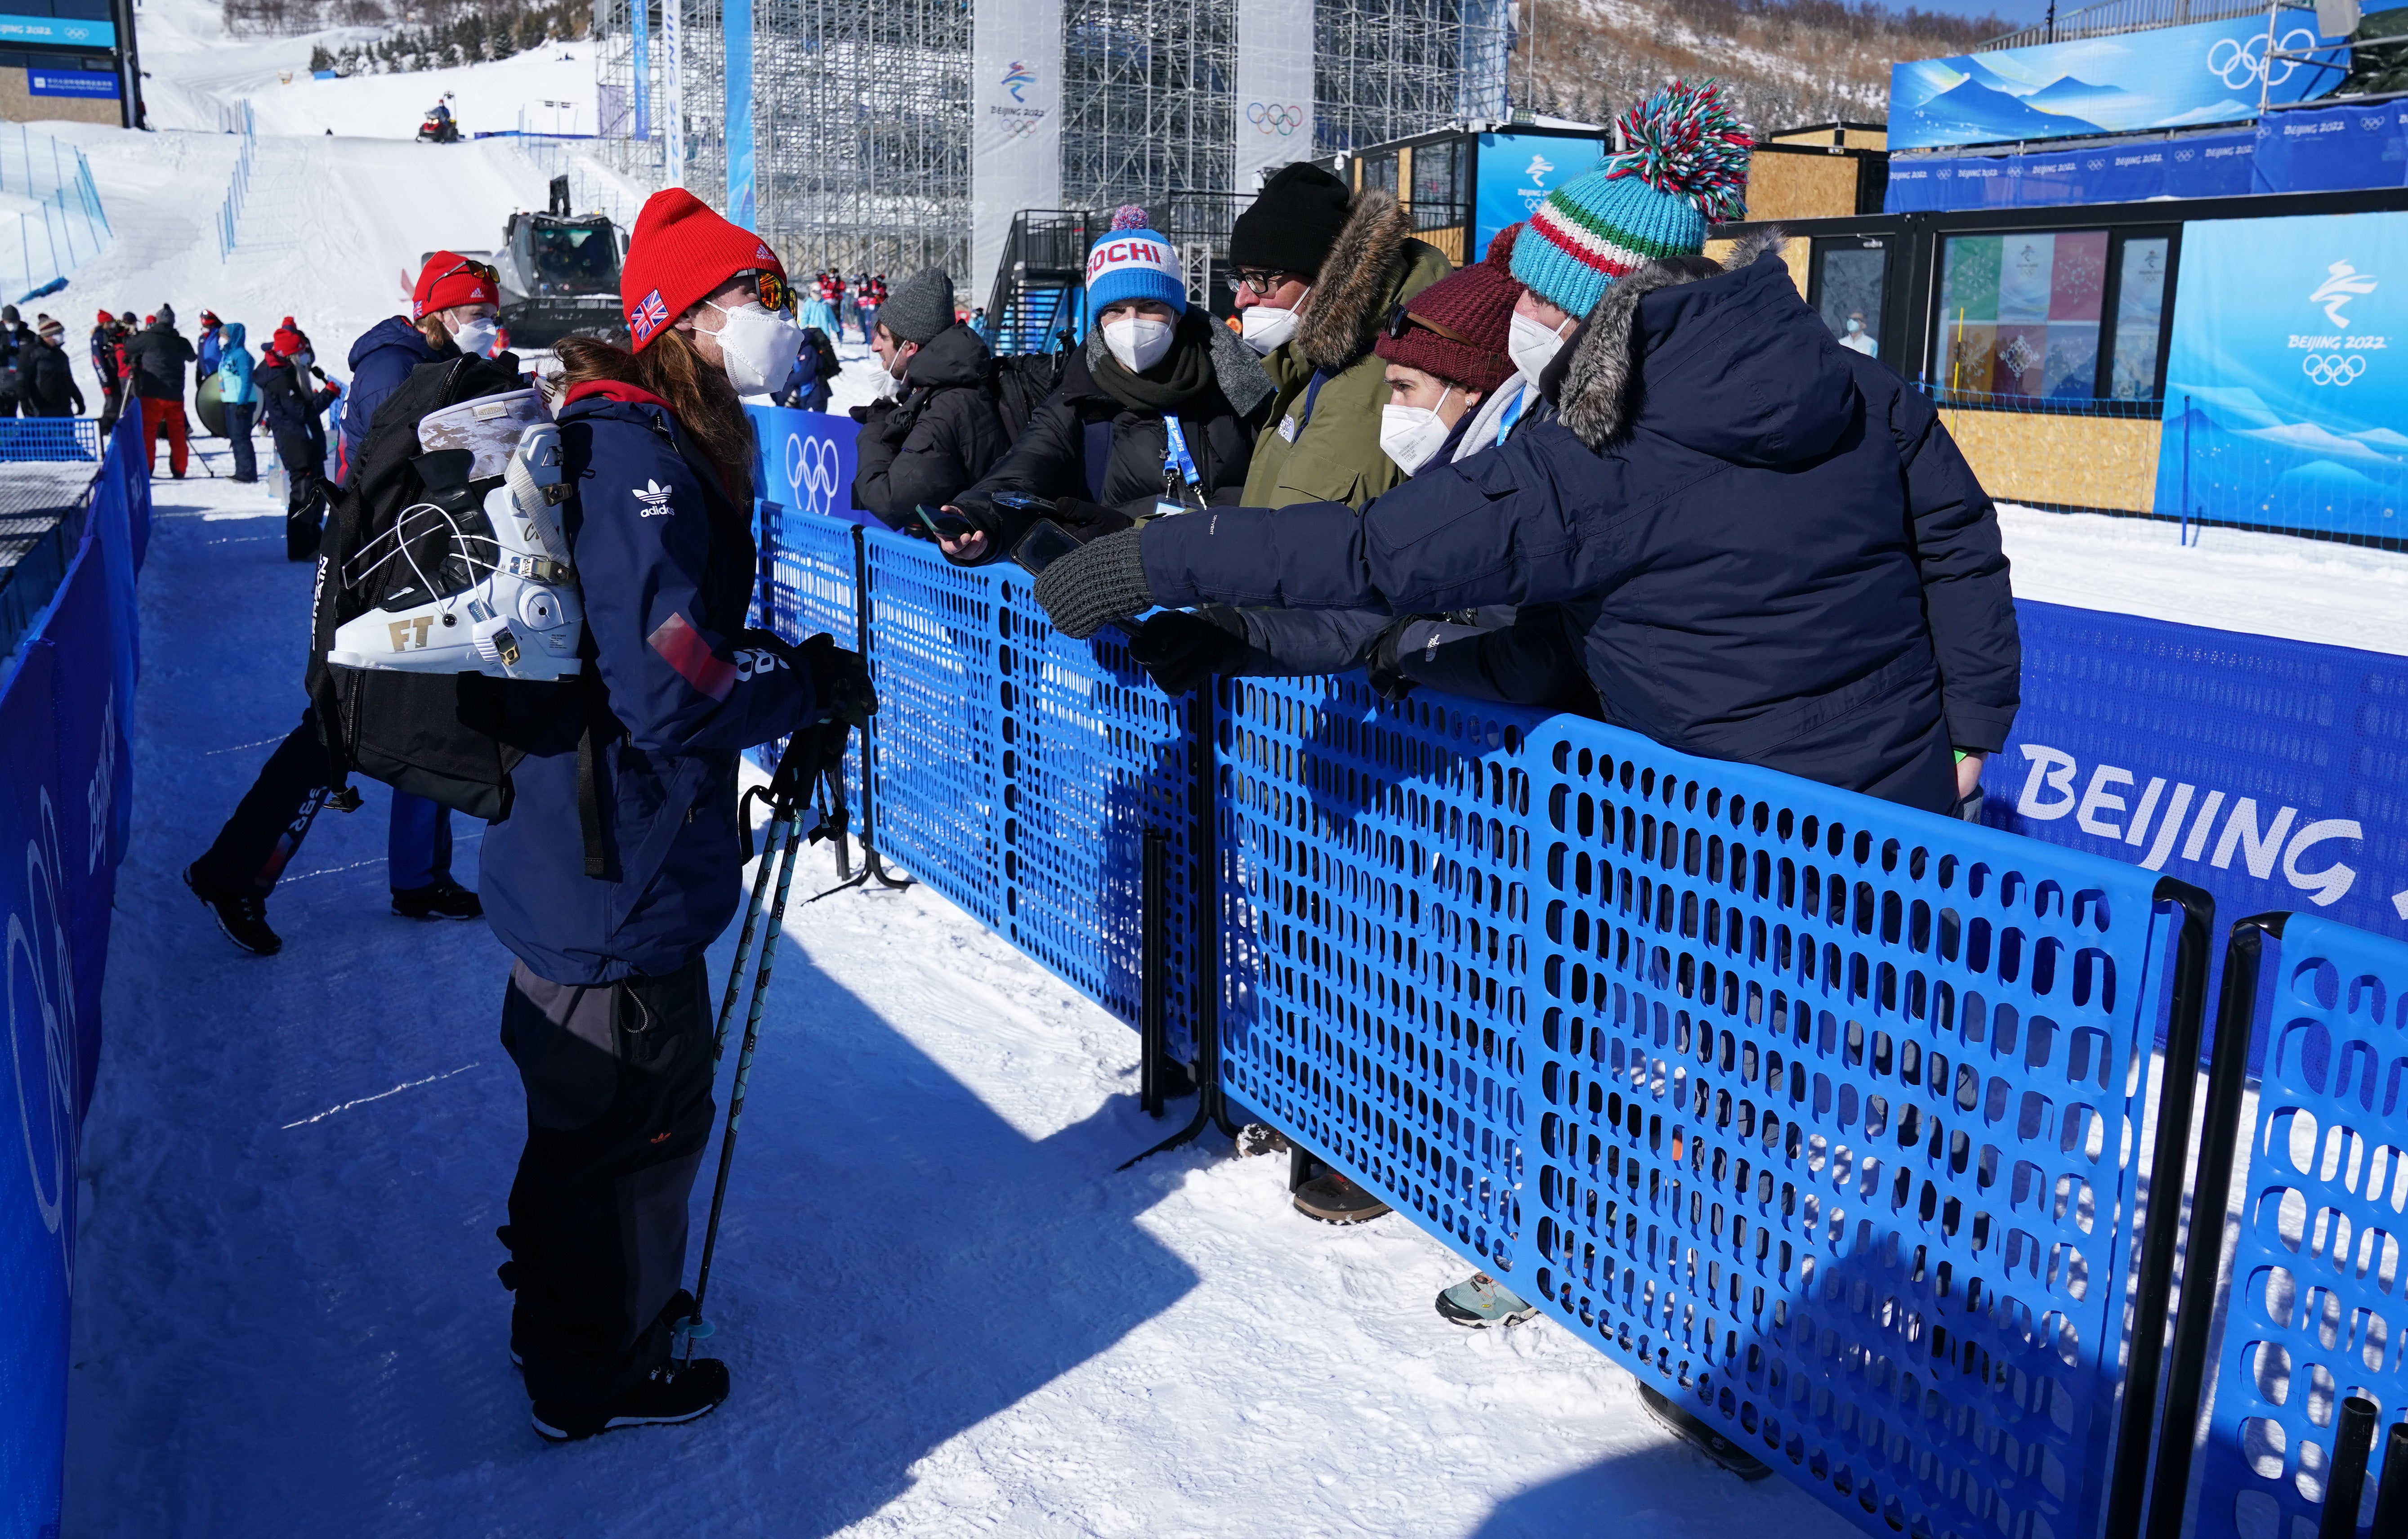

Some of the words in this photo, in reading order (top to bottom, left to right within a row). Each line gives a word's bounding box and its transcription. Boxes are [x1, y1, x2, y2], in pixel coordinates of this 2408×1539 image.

[991, 106, 1021, 117] BEIJING
[1023, 109, 1045, 117] 2022
[2283, 124, 2318, 137] BEIJING
[2319, 121, 2345, 133] 2022
[2205, 146, 2234, 158] BEIJING
[2115, 156, 2142, 167] BEIJING
[2142, 153, 2163, 163] 2022
[1958, 169, 1981, 179] BEIJING
[2032, 165, 2057, 175] BEIJING
[2058, 162, 2077, 172] 2022
[1890, 171, 1911, 181] BEIJING
[1517, 188, 1541, 198] BEIJING
[1087, 242, 1162, 282] SOCHI
[2287, 334, 2342, 352] BEIJING
[2344, 335, 2387, 350] 2022
[1172, 429, 1185, 452] BEIJING
[640, 504, 675, 518] adidas
[388, 615, 434, 653] FT
[2016, 743, 2363, 907] BEIJING
